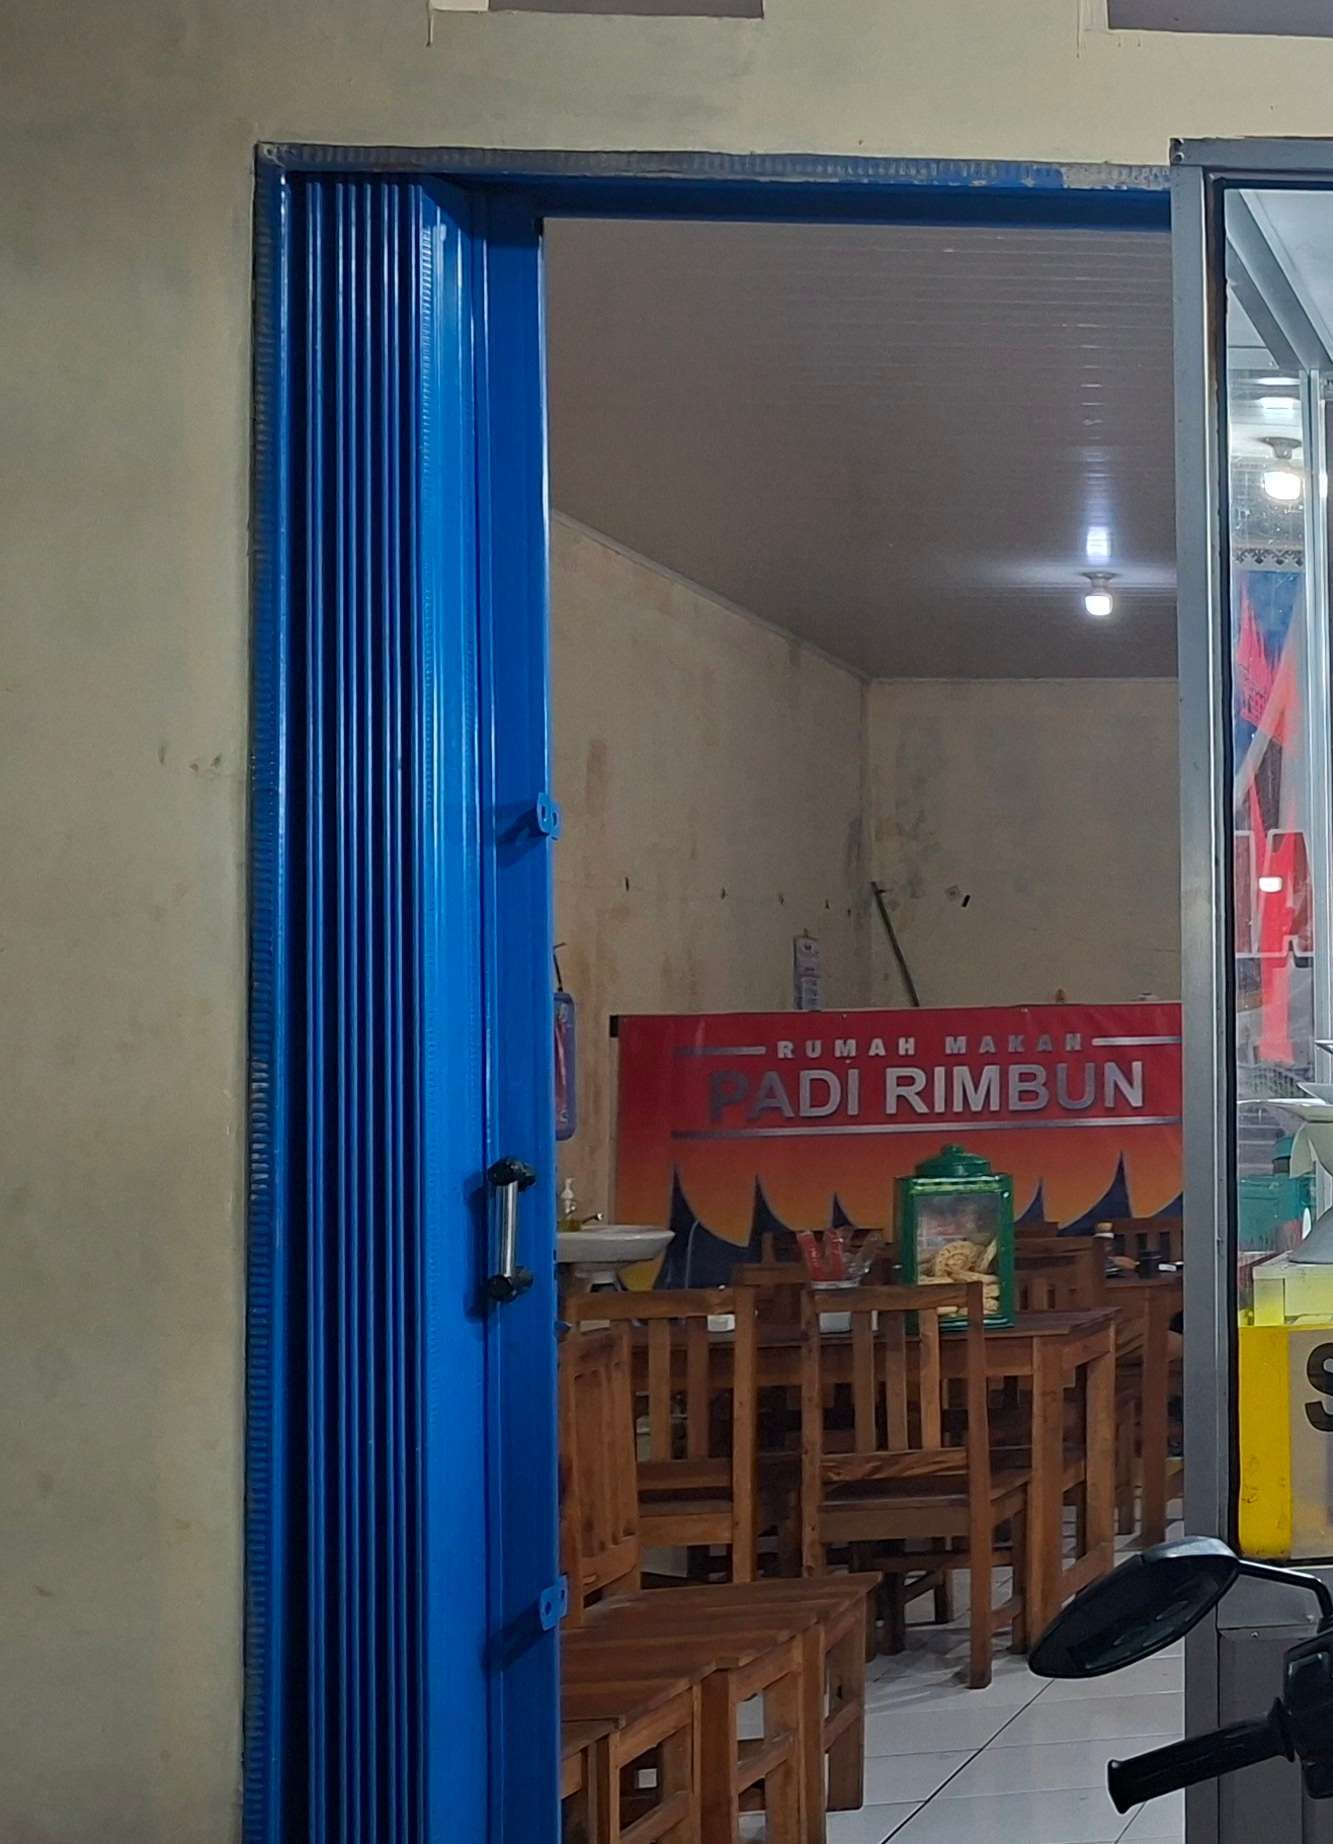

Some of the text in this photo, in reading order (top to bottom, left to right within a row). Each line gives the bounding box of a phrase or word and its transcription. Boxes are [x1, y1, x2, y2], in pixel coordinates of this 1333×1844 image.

[777, 1032, 1083, 1060] RUMAH MAKAN
[708, 1060, 1144, 1121] PADI RIMBUN
